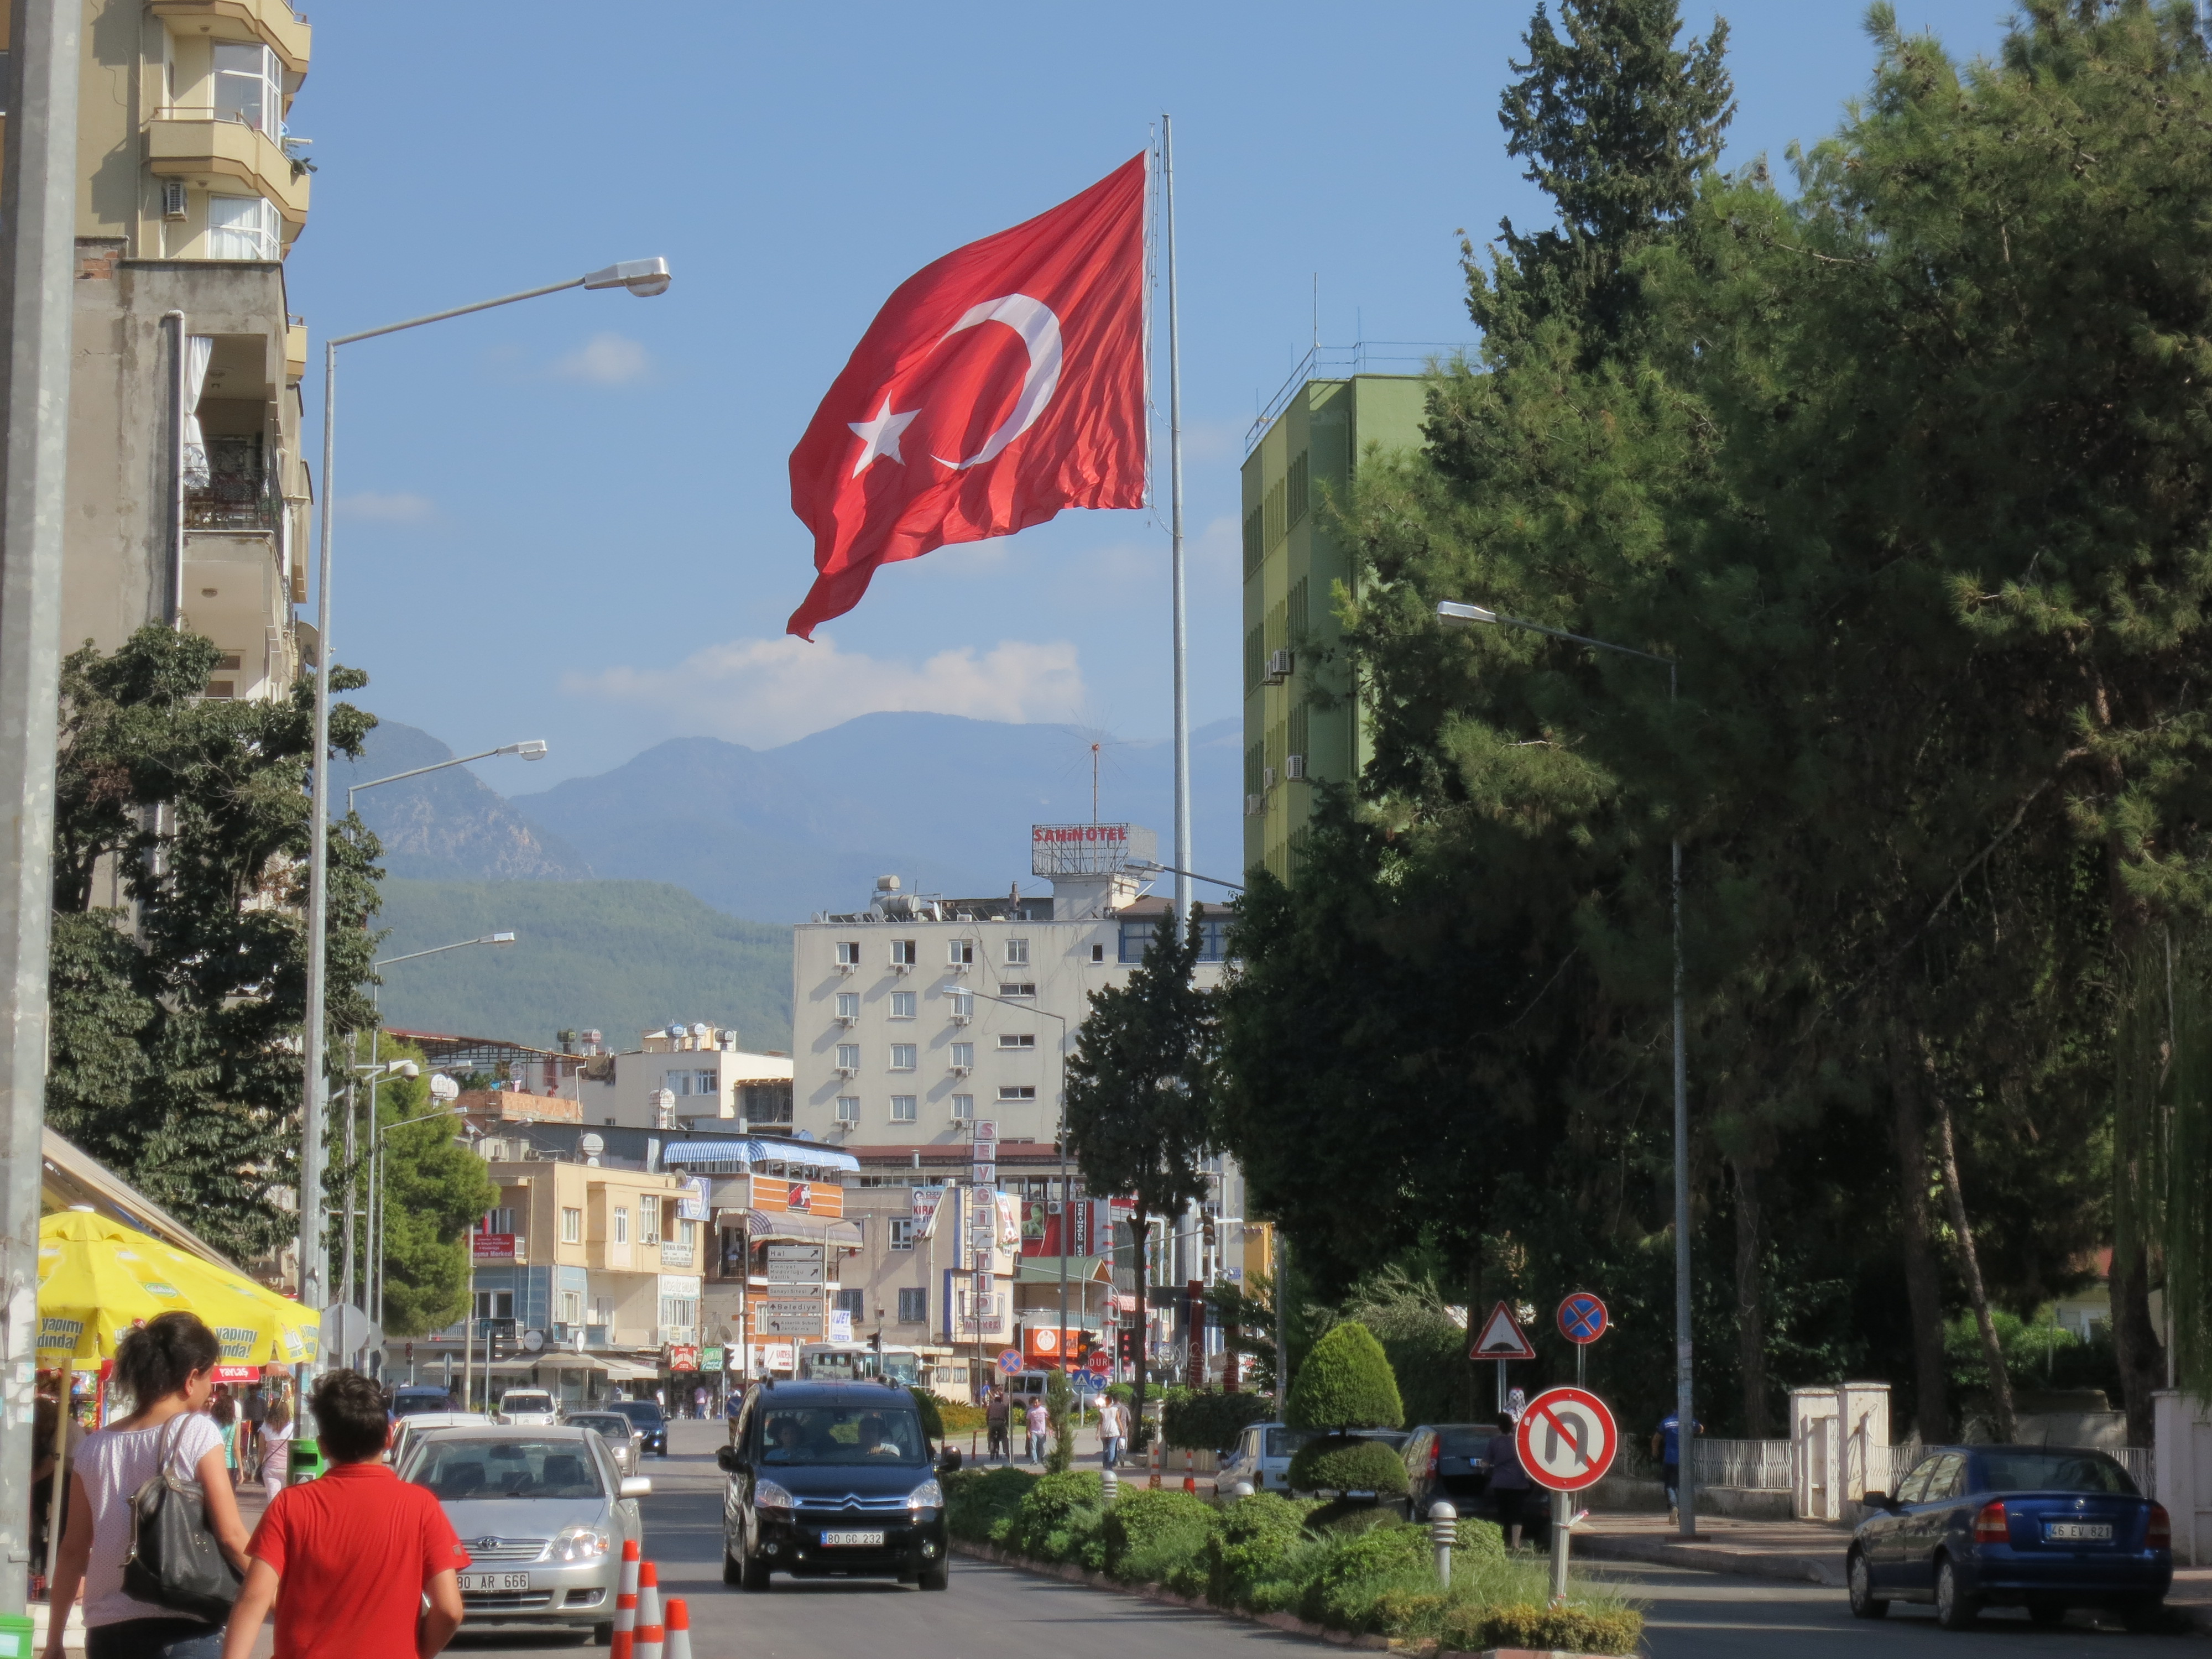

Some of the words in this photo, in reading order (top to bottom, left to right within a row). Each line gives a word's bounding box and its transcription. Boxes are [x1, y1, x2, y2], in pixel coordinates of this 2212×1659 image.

[1086, 827, 1127, 841] OTEL
[914, 1202, 937, 1215] KİRA
[1089, 1358, 1108, 1367] DUR
[2051, 1526, 2064, 1536] 46
[2071, 1526, 2084, 1537] EV
[2090, 1527, 2110, 1537] 821
[828, 1534, 840, 1543] 80
[846, 1534, 858, 1543] GC
[863, 1534, 881, 1543] 232
[457, 1576, 471, 1589] 80
[481, 1575, 495, 1589] AR
[504, 1574, 527, 1588] 666
